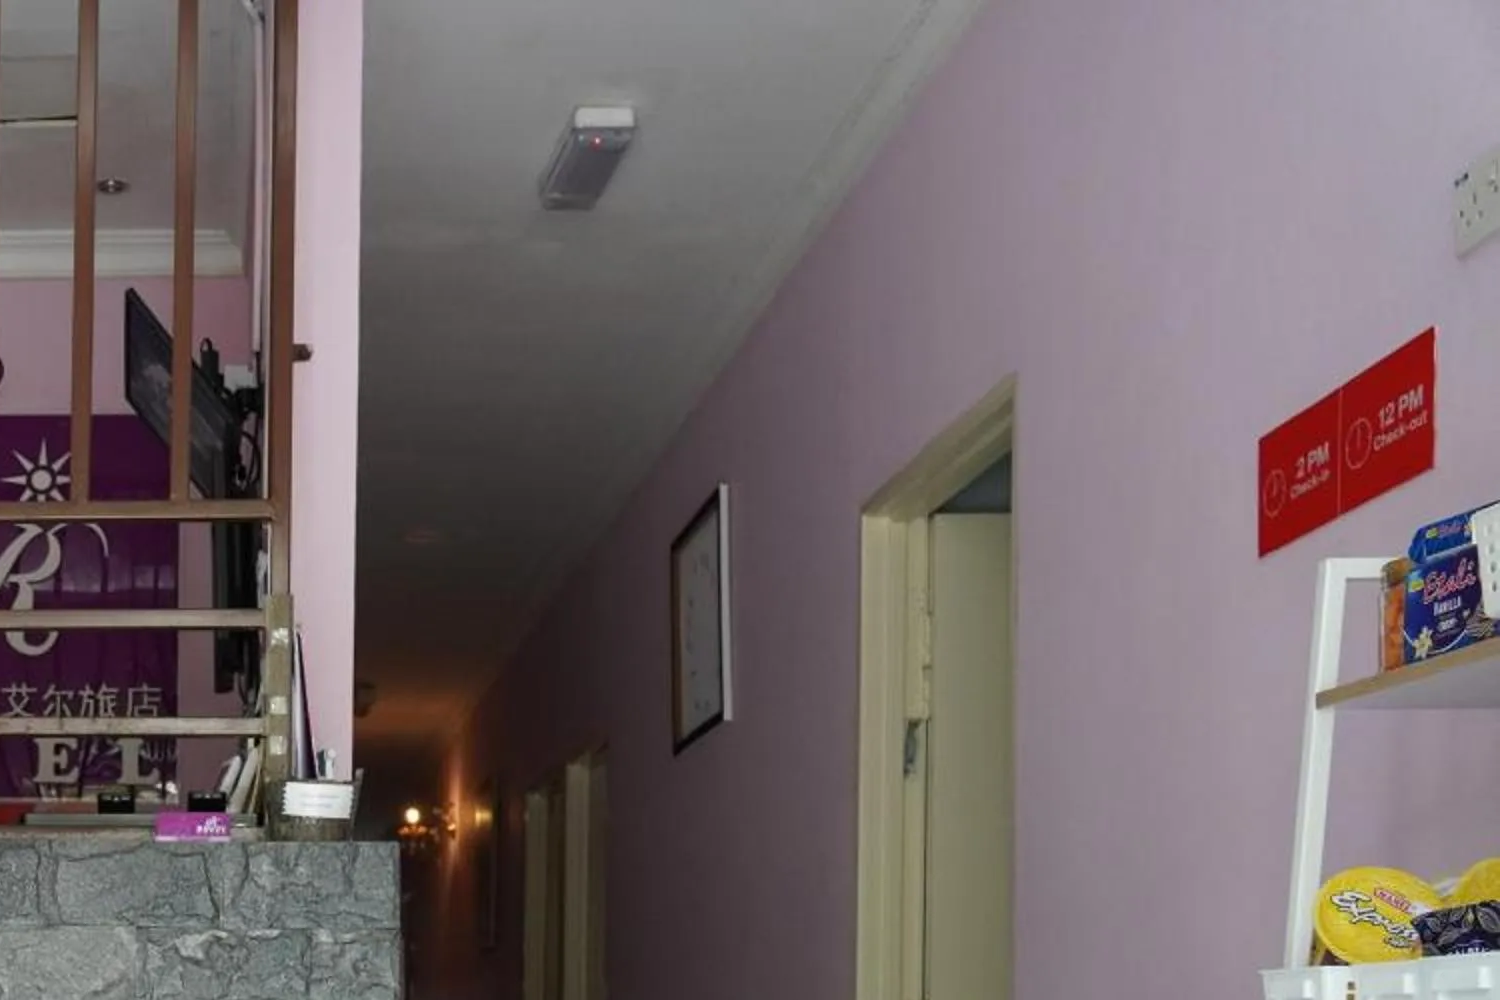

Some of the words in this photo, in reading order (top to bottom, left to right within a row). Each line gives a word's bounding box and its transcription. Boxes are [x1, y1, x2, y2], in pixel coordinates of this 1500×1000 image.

[1378, 400, 1396, 429] 12
[1397, 383, 1425, 418] PM
[1373, 409, 1429, 450] Check-out
[1295, 456, 1306, 479] 2
[1307, 441, 1330, 473] PM
[0, 682, 163, 717] 艾尔旅店
